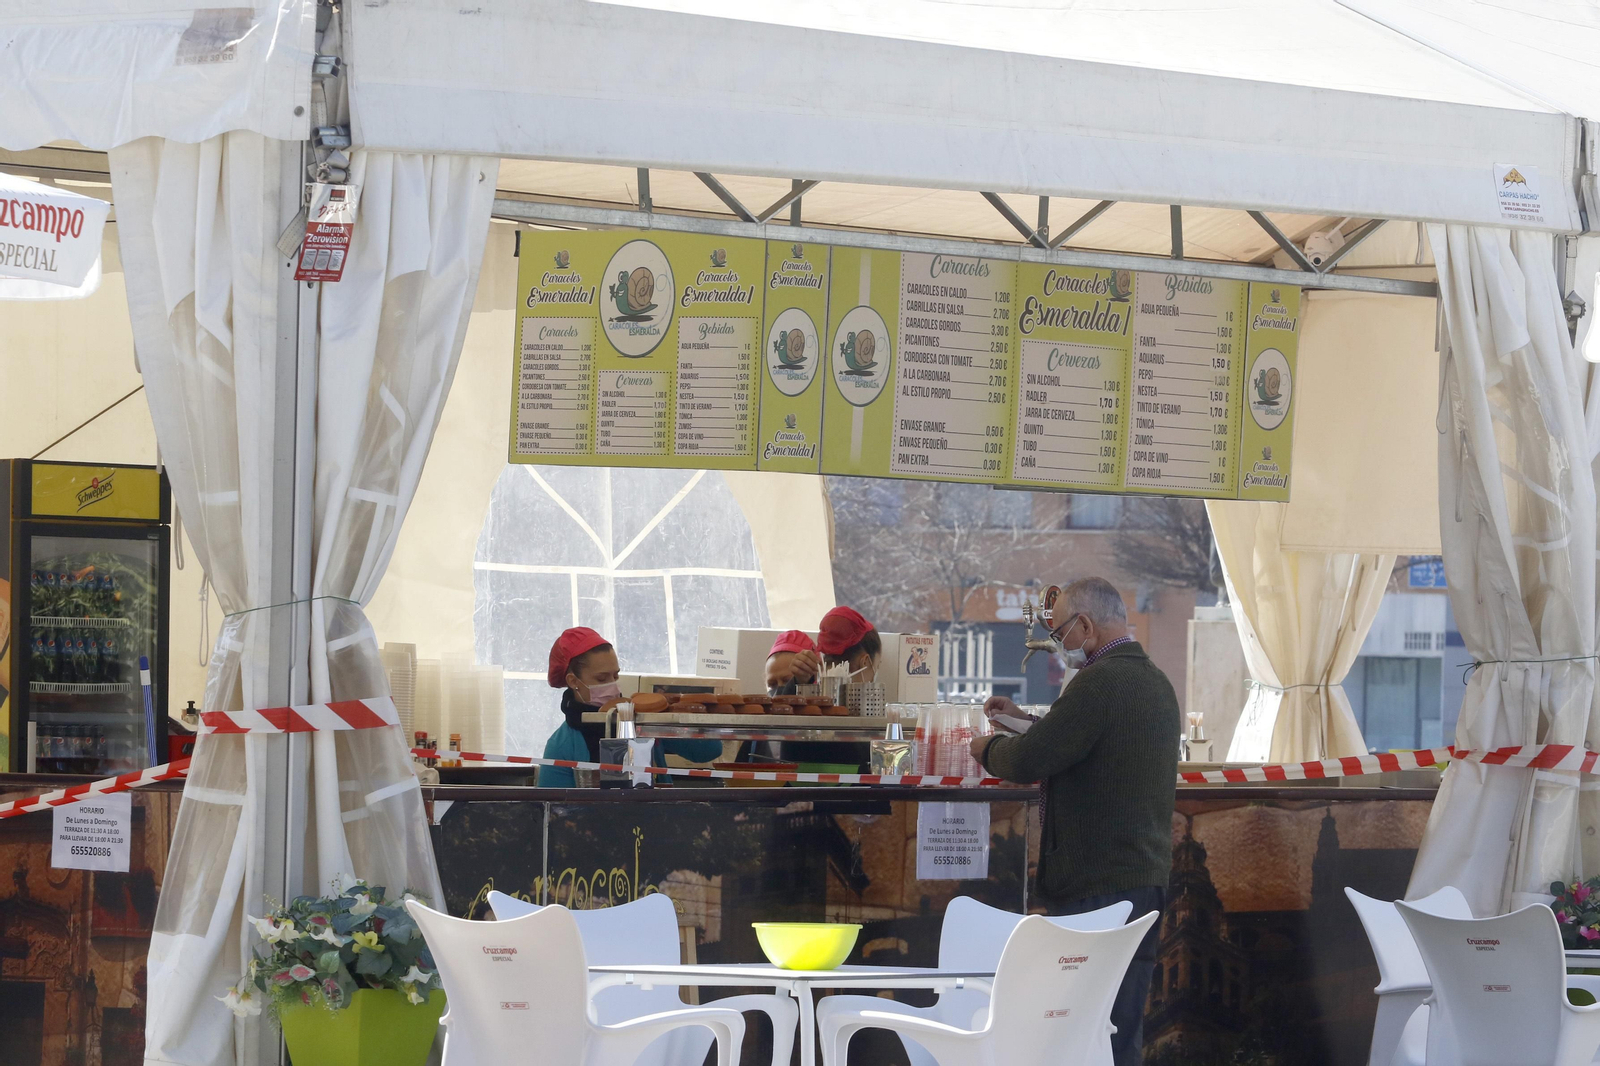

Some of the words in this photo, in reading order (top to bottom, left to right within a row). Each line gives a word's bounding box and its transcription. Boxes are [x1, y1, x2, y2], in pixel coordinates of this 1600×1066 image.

[1499, 190, 1519, 198] CARPAS
[1520, 192, 1537, 200] HACHO
[316, 224, 344, 234] Alarma
[307, 233, 348, 244] Zerovision
[781, 260, 812, 273] Caracoles
[930, 254, 990, 279] Caracoles
[541, 270, 580, 287] Caracoles
[696, 270, 738, 286] Caracoles
[1043, 269, 1107, 296] Caracoles
[907, 283, 940, 297] CARACOLES
[941, 286, 949, 298] EN
[949, 287, 968, 299] CALDO
[1164, 275, 1213, 301] Bebidas
[906, 300, 937, 314] CABRILLAS
[938, 303, 946, 314] EN
[946, 304, 964, 316] SALSA
[1140, 303, 1156, 316] AGUA
[1156, 304, 1180, 317] PEQUEÑA
[1262, 304, 1288, 316] Caracoles
[608, 322, 639, 330] CARACOLES
[906, 317, 938, 331] CARACOLES
[939, 320, 962, 332] GORDOS
[539, 326, 578, 341] Caracoles
[629, 327, 660, 336] ESMERALDA
[698, 323, 735, 340] Bebidas
[524, 343, 545, 351] CARACOLES
[681, 342, 691, 350] AGUA
[692, 342, 710, 351] PEQUEÑA
[904, 334, 940, 348] PICANTONES
[1140, 336, 1156, 348] FANTA
[549, 354, 562, 362] SALSA
[904, 351, 936, 364] CORDOBESA
[938, 354, 950, 366] CON
[951, 355, 973, 368] TOMATE
[1047, 348, 1102, 372] Cervezas
[1139, 352, 1164, 365] AQUARIUS
[522, 373, 546, 381] PICANTONES
[902, 368, 908, 378] A
[908, 369, 916, 380] LA
[916, 370, 951, 382] CARBONARA
[1026, 374, 1036, 385] SIN
[1036, 375, 1061, 387] ALCOHOL
[1138, 369, 1154, 380] PEPSI
[616, 374, 653, 389] Cervezas
[902, 385, 910, 396] AL
[910, 386, 930, 398] ESTILO
[930, 388, 951, 400] PROPIO
[1026, 391, 1047, 402] RADLER
[1138, 385, 1158, 397] NESTEA
[602, 400, 616, 408] RADLER
[1136, 401, 1152, 413] TINTO
[1152, 402, 1160, 414] DE
[1160, 404, 1181, 416] VERANO
[1024, 407, 1042, 418] JARRA
[1043, 408, 1050, 420] DE
[1050, 409, 1075, 421] CERVEZA
[900, 419, 922, 432] ENVASE
[923, 421, 946, 434] GRANDE
[1136, 416, 1154, 430] TÓNICA
[1024, 424, 1044, 436] QUINTO
[775, 431, 804, 444] Caracoles
[899, 436, 921, 449] ENVASE
[922, 437, 948, 451] PEQUEÑO
[1134, 434, 1154, 446] ZUMOS
[1022, 440, 1037, 452] TUBO
[898, 454, 910, 466] PAN
[910, 454, 929, 467] EXTRA
[1020, 455, 1036, 468] CAÑA
[1133, 451, 1148, 462] COPA
[1148, 452, 1155, 463] DE
[1156, 453, 1168, 464] VINO
[1132, 467, 1146, 478] COPA
[1146, 468, 1162, 480] RIOJA
[1253, 462, 1278, 474] Caracoles
[78, 481, 113, 507] Schweppes
[906, 637, 920, 645] PATATAS
[921, 638, 934, 646] FRITAS
[80, 806, 104, 815] HORARIO
[66, 816, 73, 824] De
[94, 818, 117, 827] Domingo
[956, 828, 977, 836] Domingo
[71, 846, 111, 856] 655520886
[934, 856, 971, 865] 655520886
[1466, 938, 1500, 946] Cruzcampo
[482, 946, 518, 955] Cruzcampo
[1058, 955, 1088, 964] Cruzcampo
